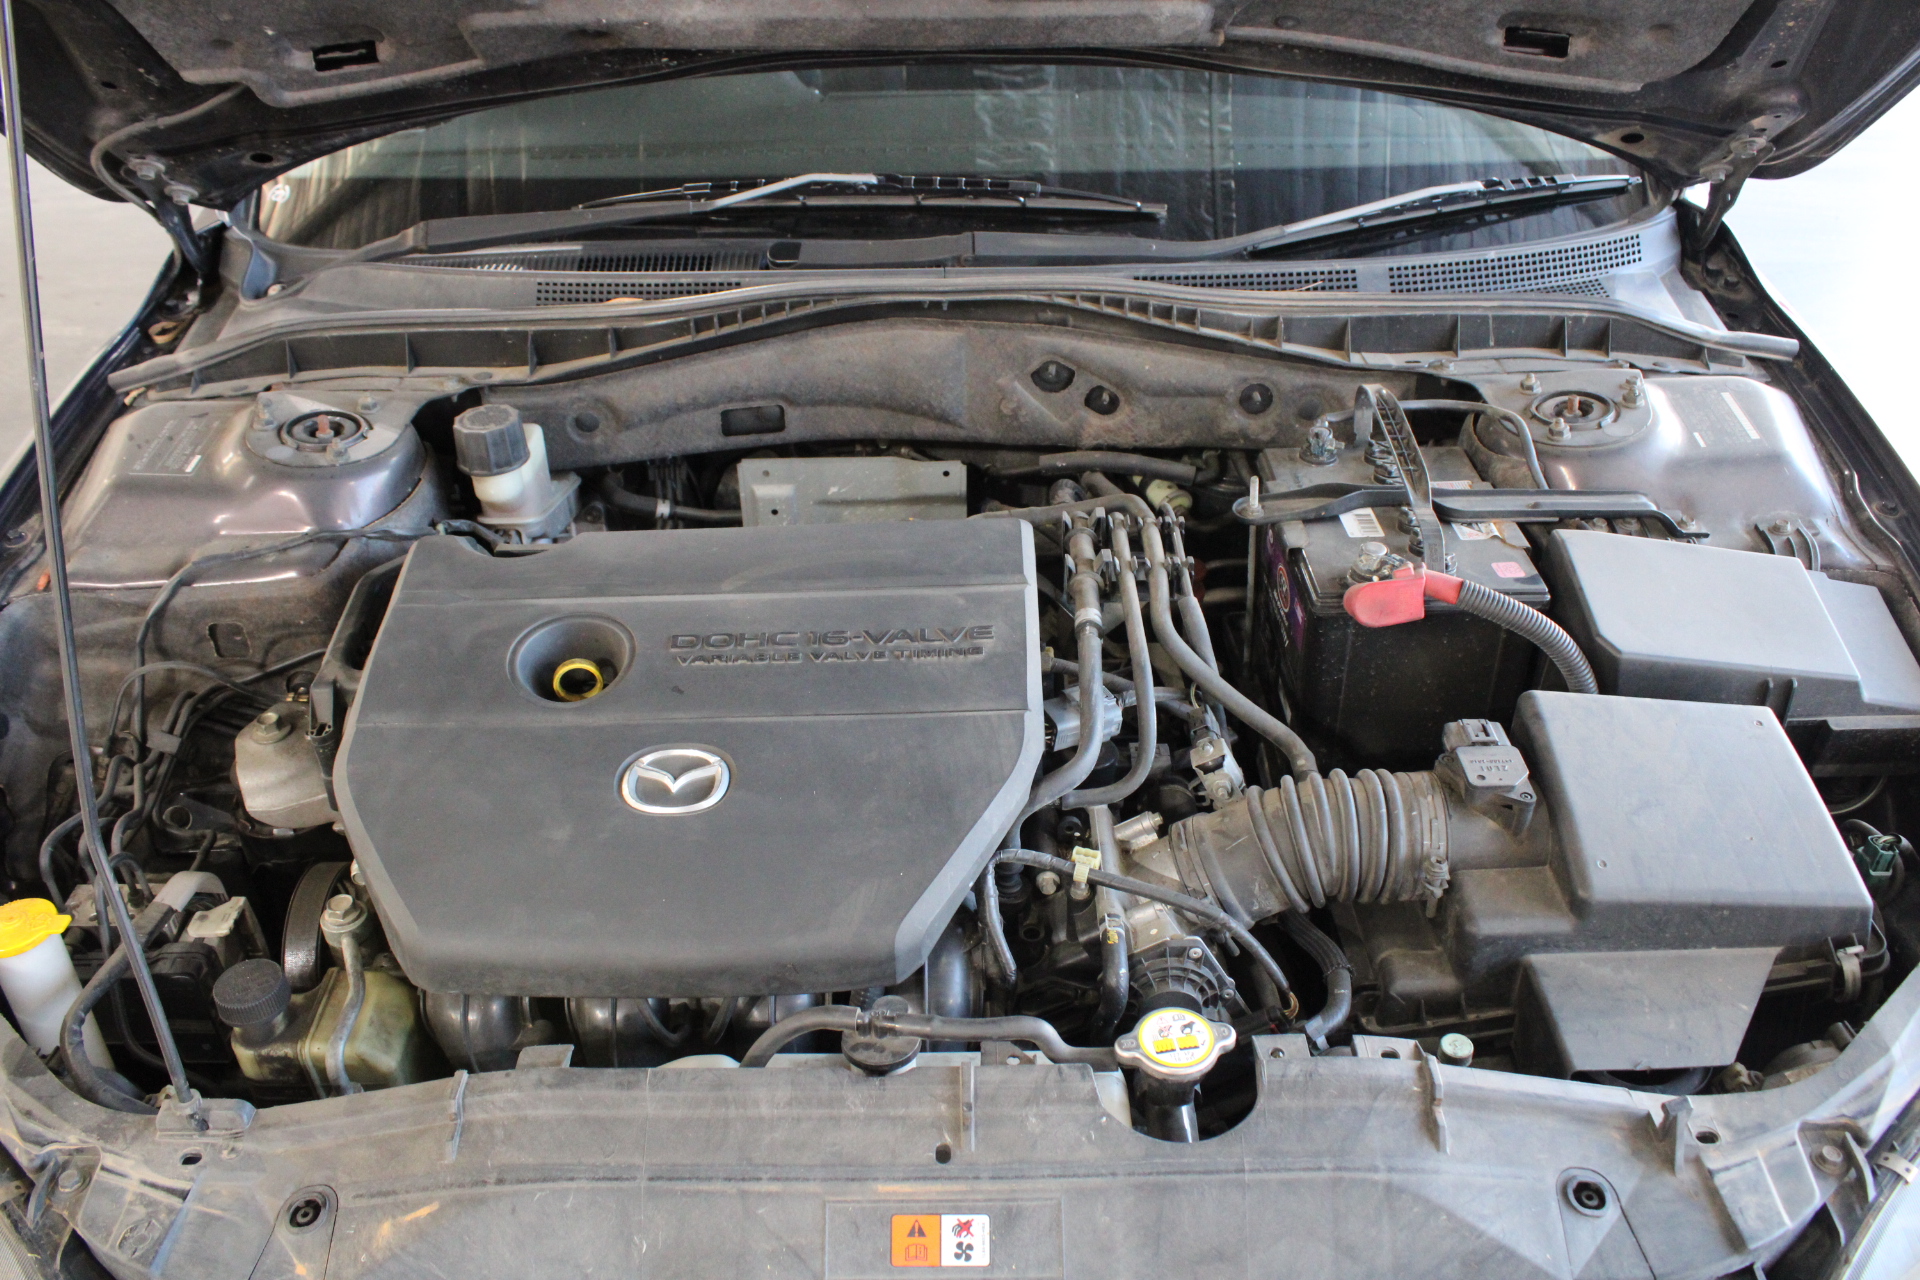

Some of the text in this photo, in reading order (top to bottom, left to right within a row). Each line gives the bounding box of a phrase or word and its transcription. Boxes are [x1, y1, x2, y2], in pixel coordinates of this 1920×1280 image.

[670, 625, 995, 651] DOHC 16-VALVE
[677, 646, 985, 666] VARIABLE VALVE TIMING
